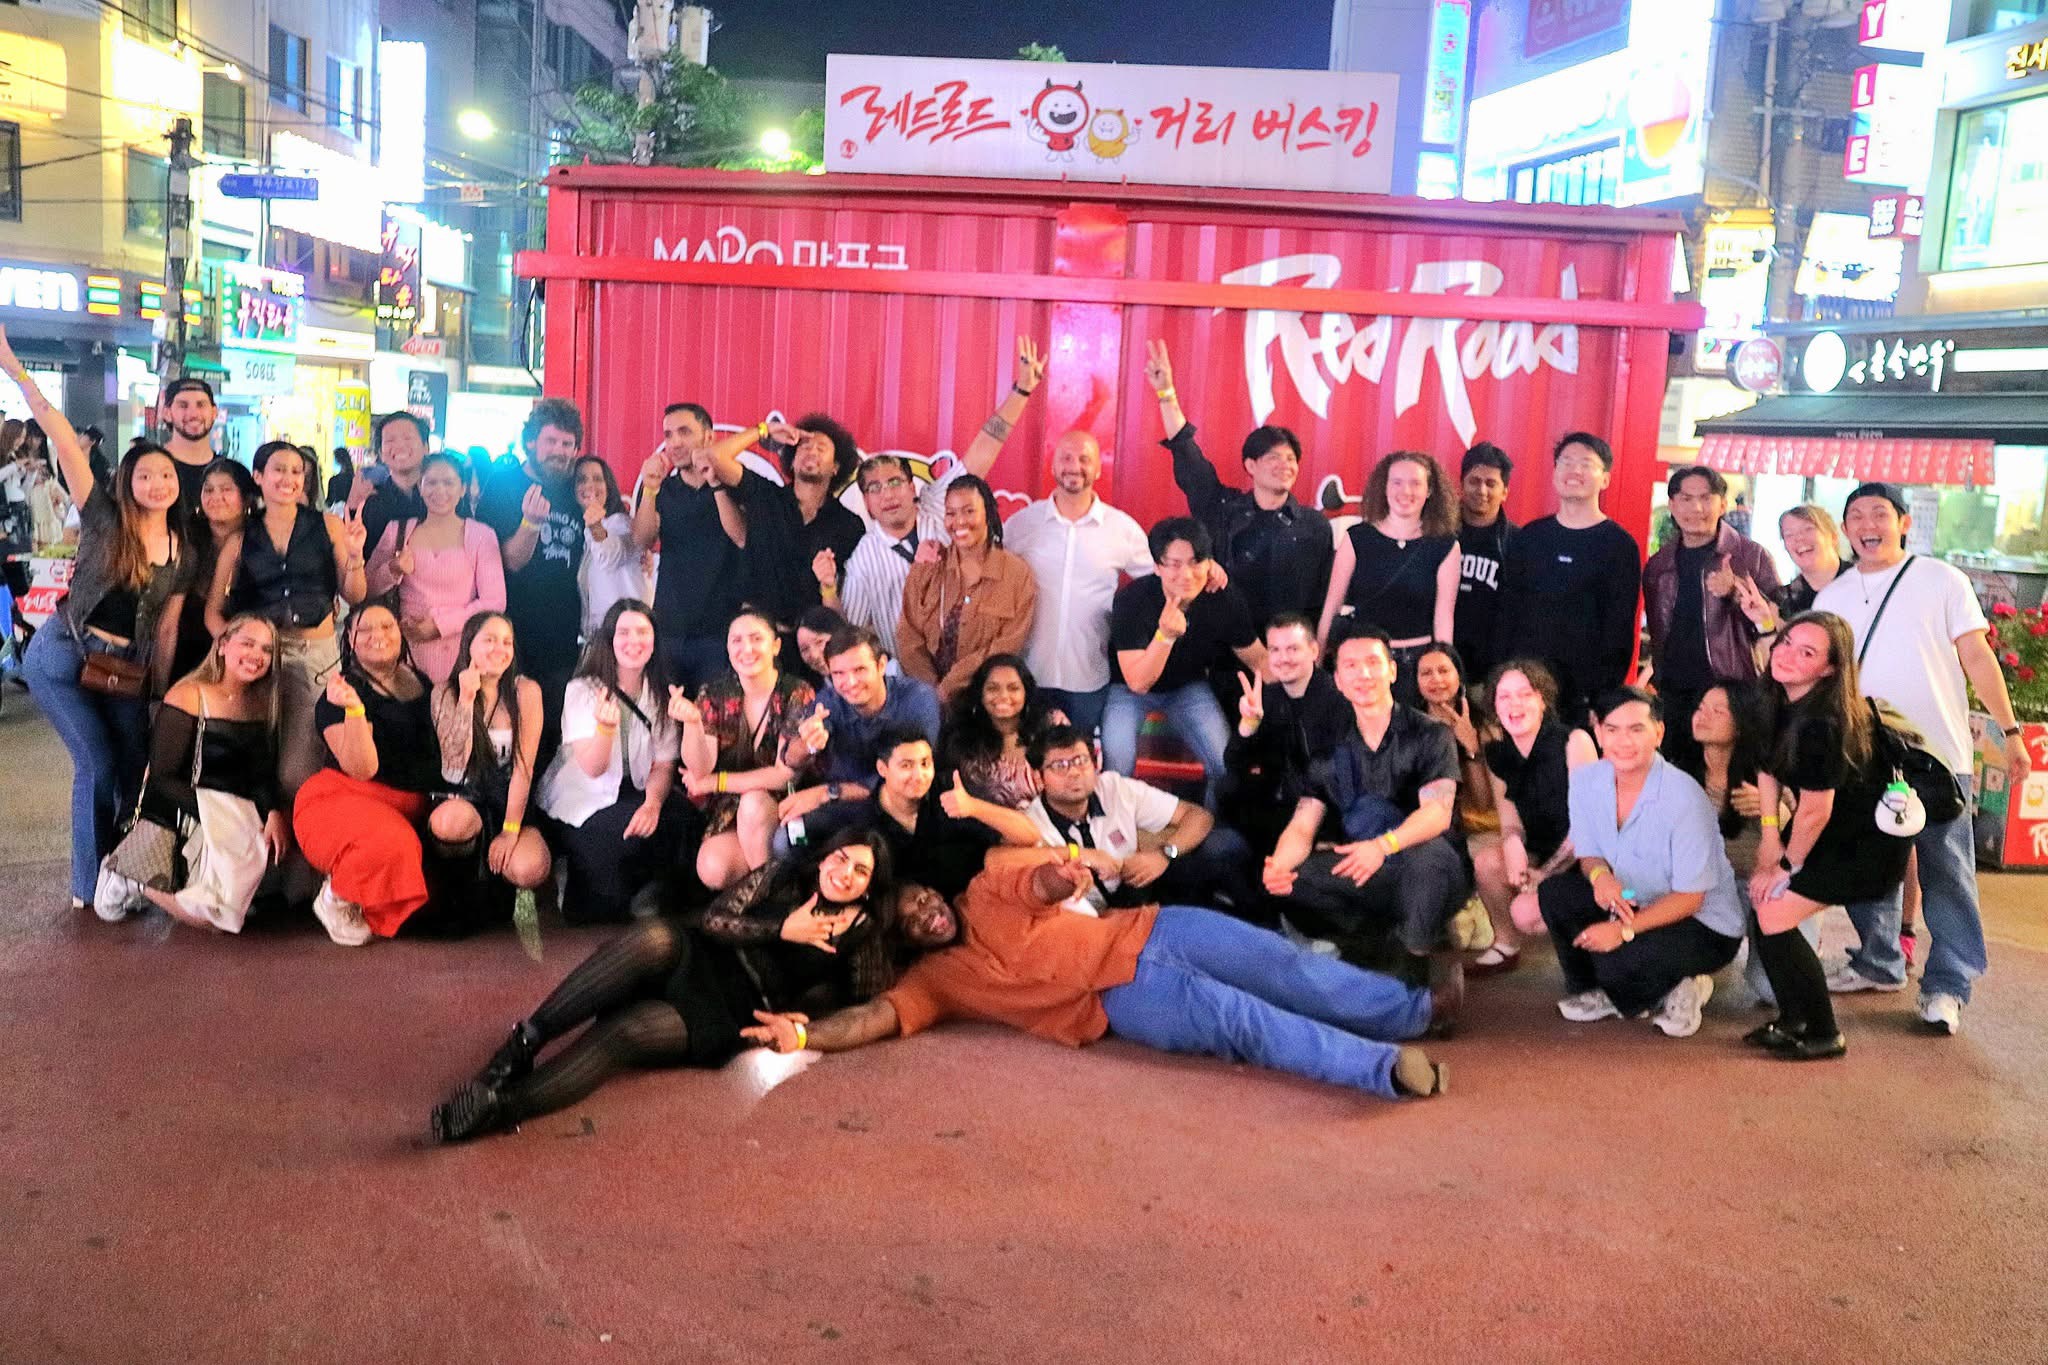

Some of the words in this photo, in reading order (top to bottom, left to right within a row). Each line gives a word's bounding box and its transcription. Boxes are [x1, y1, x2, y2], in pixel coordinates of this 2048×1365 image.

[840, 81, 1011, 144] 레드로드
[1150, 98, 1236, 149] 거리
[1253, 101, 1379, 158] 버스킹
[406, 341, 440, 355] OPEN
[1460, 554, 1499, 590] OUL
